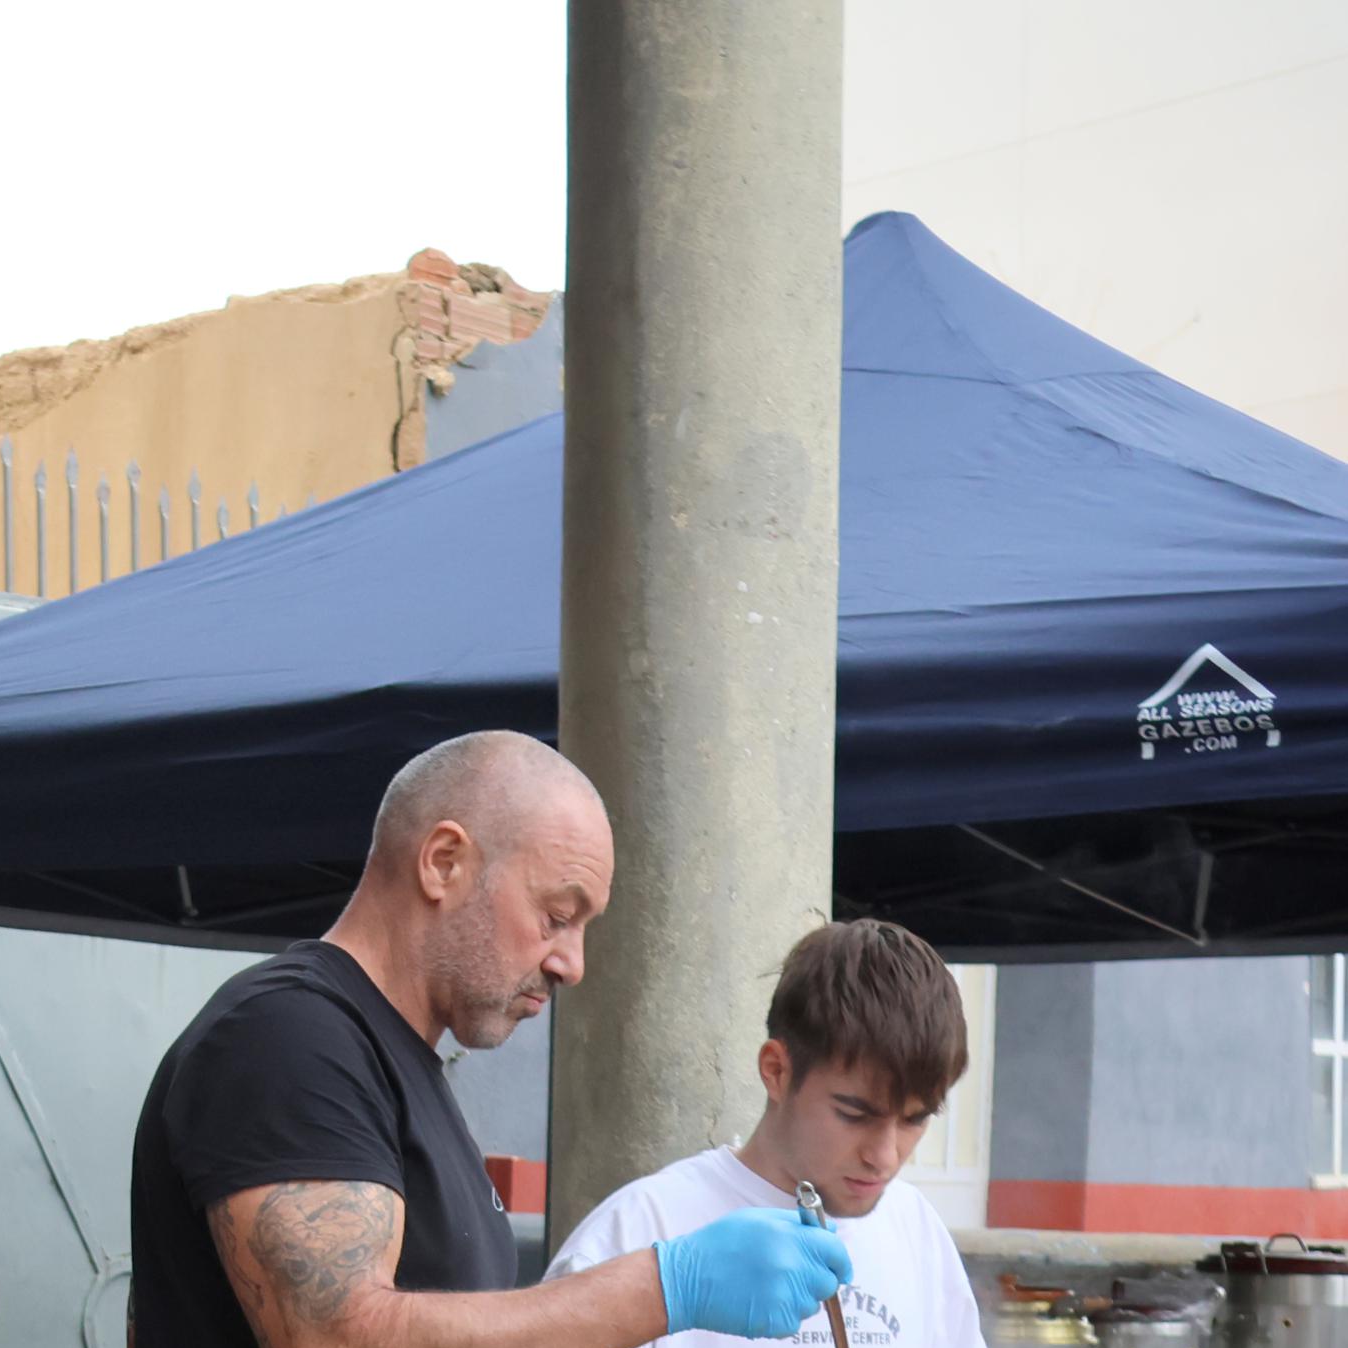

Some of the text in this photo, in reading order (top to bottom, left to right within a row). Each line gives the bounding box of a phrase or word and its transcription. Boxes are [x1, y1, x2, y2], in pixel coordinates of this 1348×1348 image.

[1136, 698, 1275, 722] ALL SEASONS
[1137, 714, 1276, 741] GAZEBOS
[1183, 735, 1239, 754] .COM
[851, 1331, 891, 1345] CENTER
